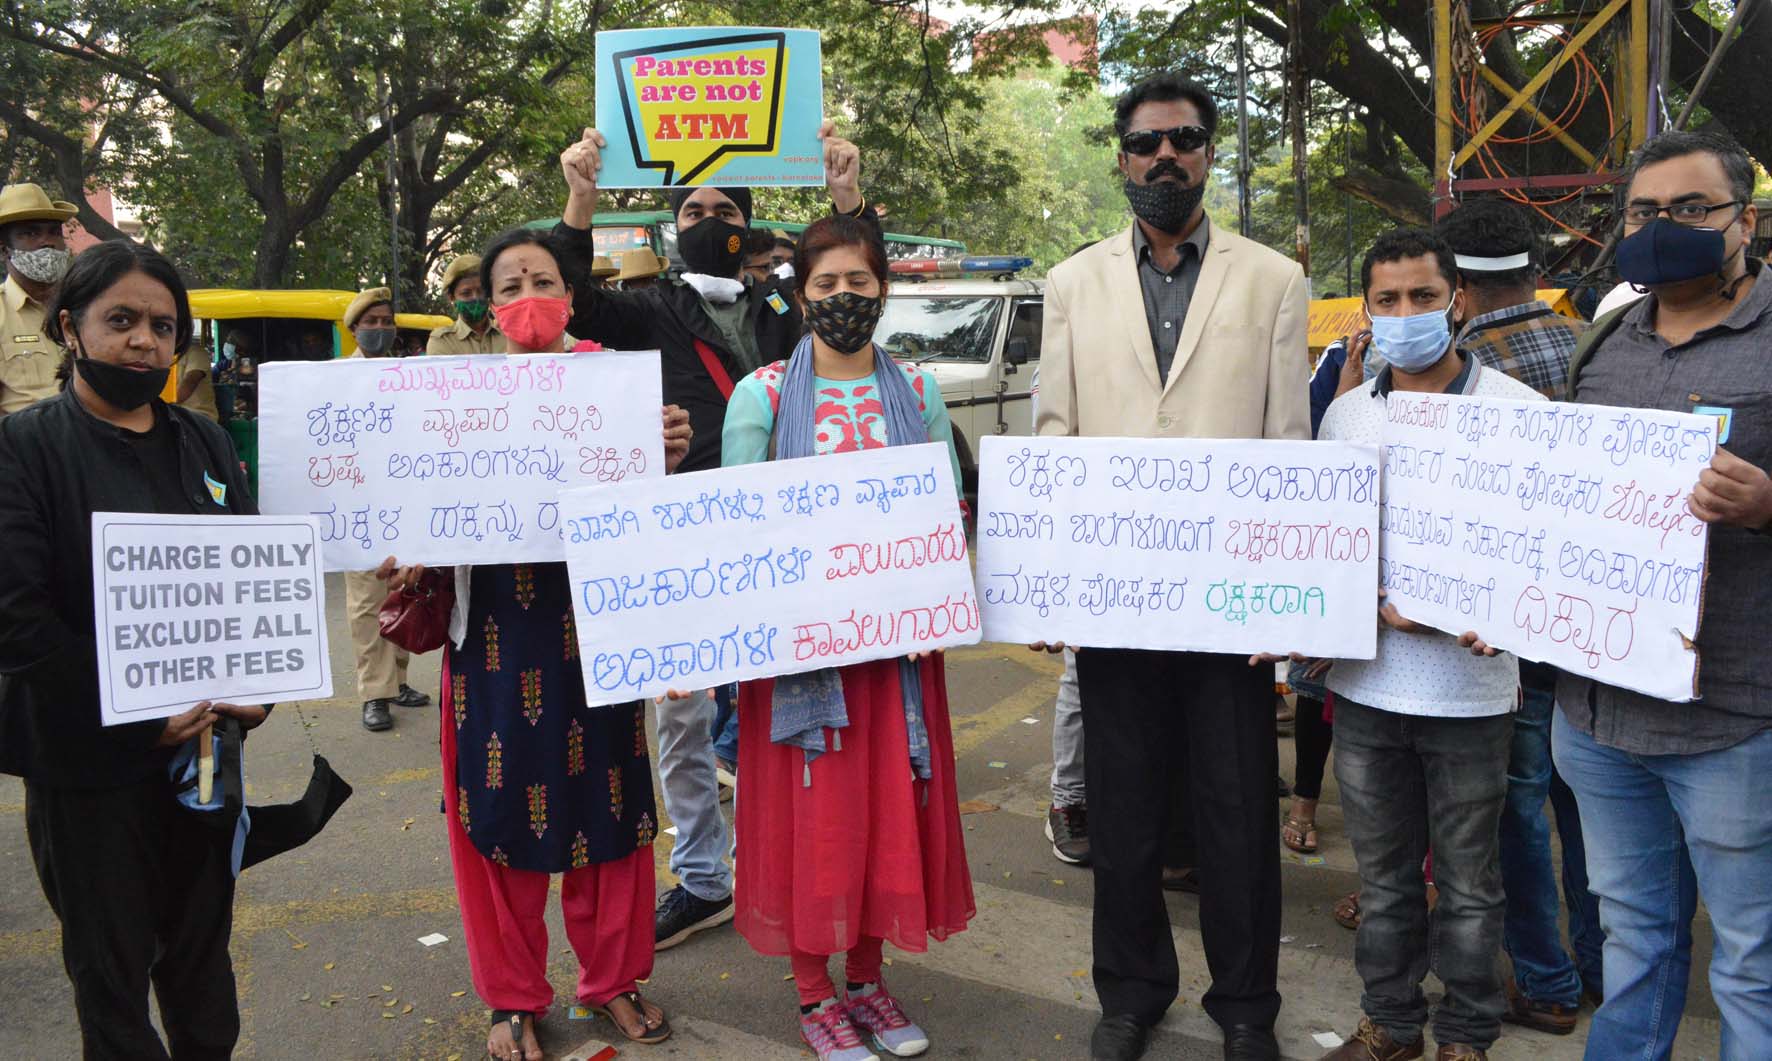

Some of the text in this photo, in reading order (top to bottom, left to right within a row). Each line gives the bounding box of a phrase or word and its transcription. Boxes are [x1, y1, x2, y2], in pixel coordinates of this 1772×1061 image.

[634, 55, 767, 78] Parents
[640, 79, 763, 103] are not
[654, 113, 750, 140] ATM
[106, 543, 313, 572] CHARGE ONLY
[109, 577, 313, 612] TUITION FEES
[114, 612, 313, 651] EXCLUDE ALL
[125, 648, 306, 690] OTHER FEES
